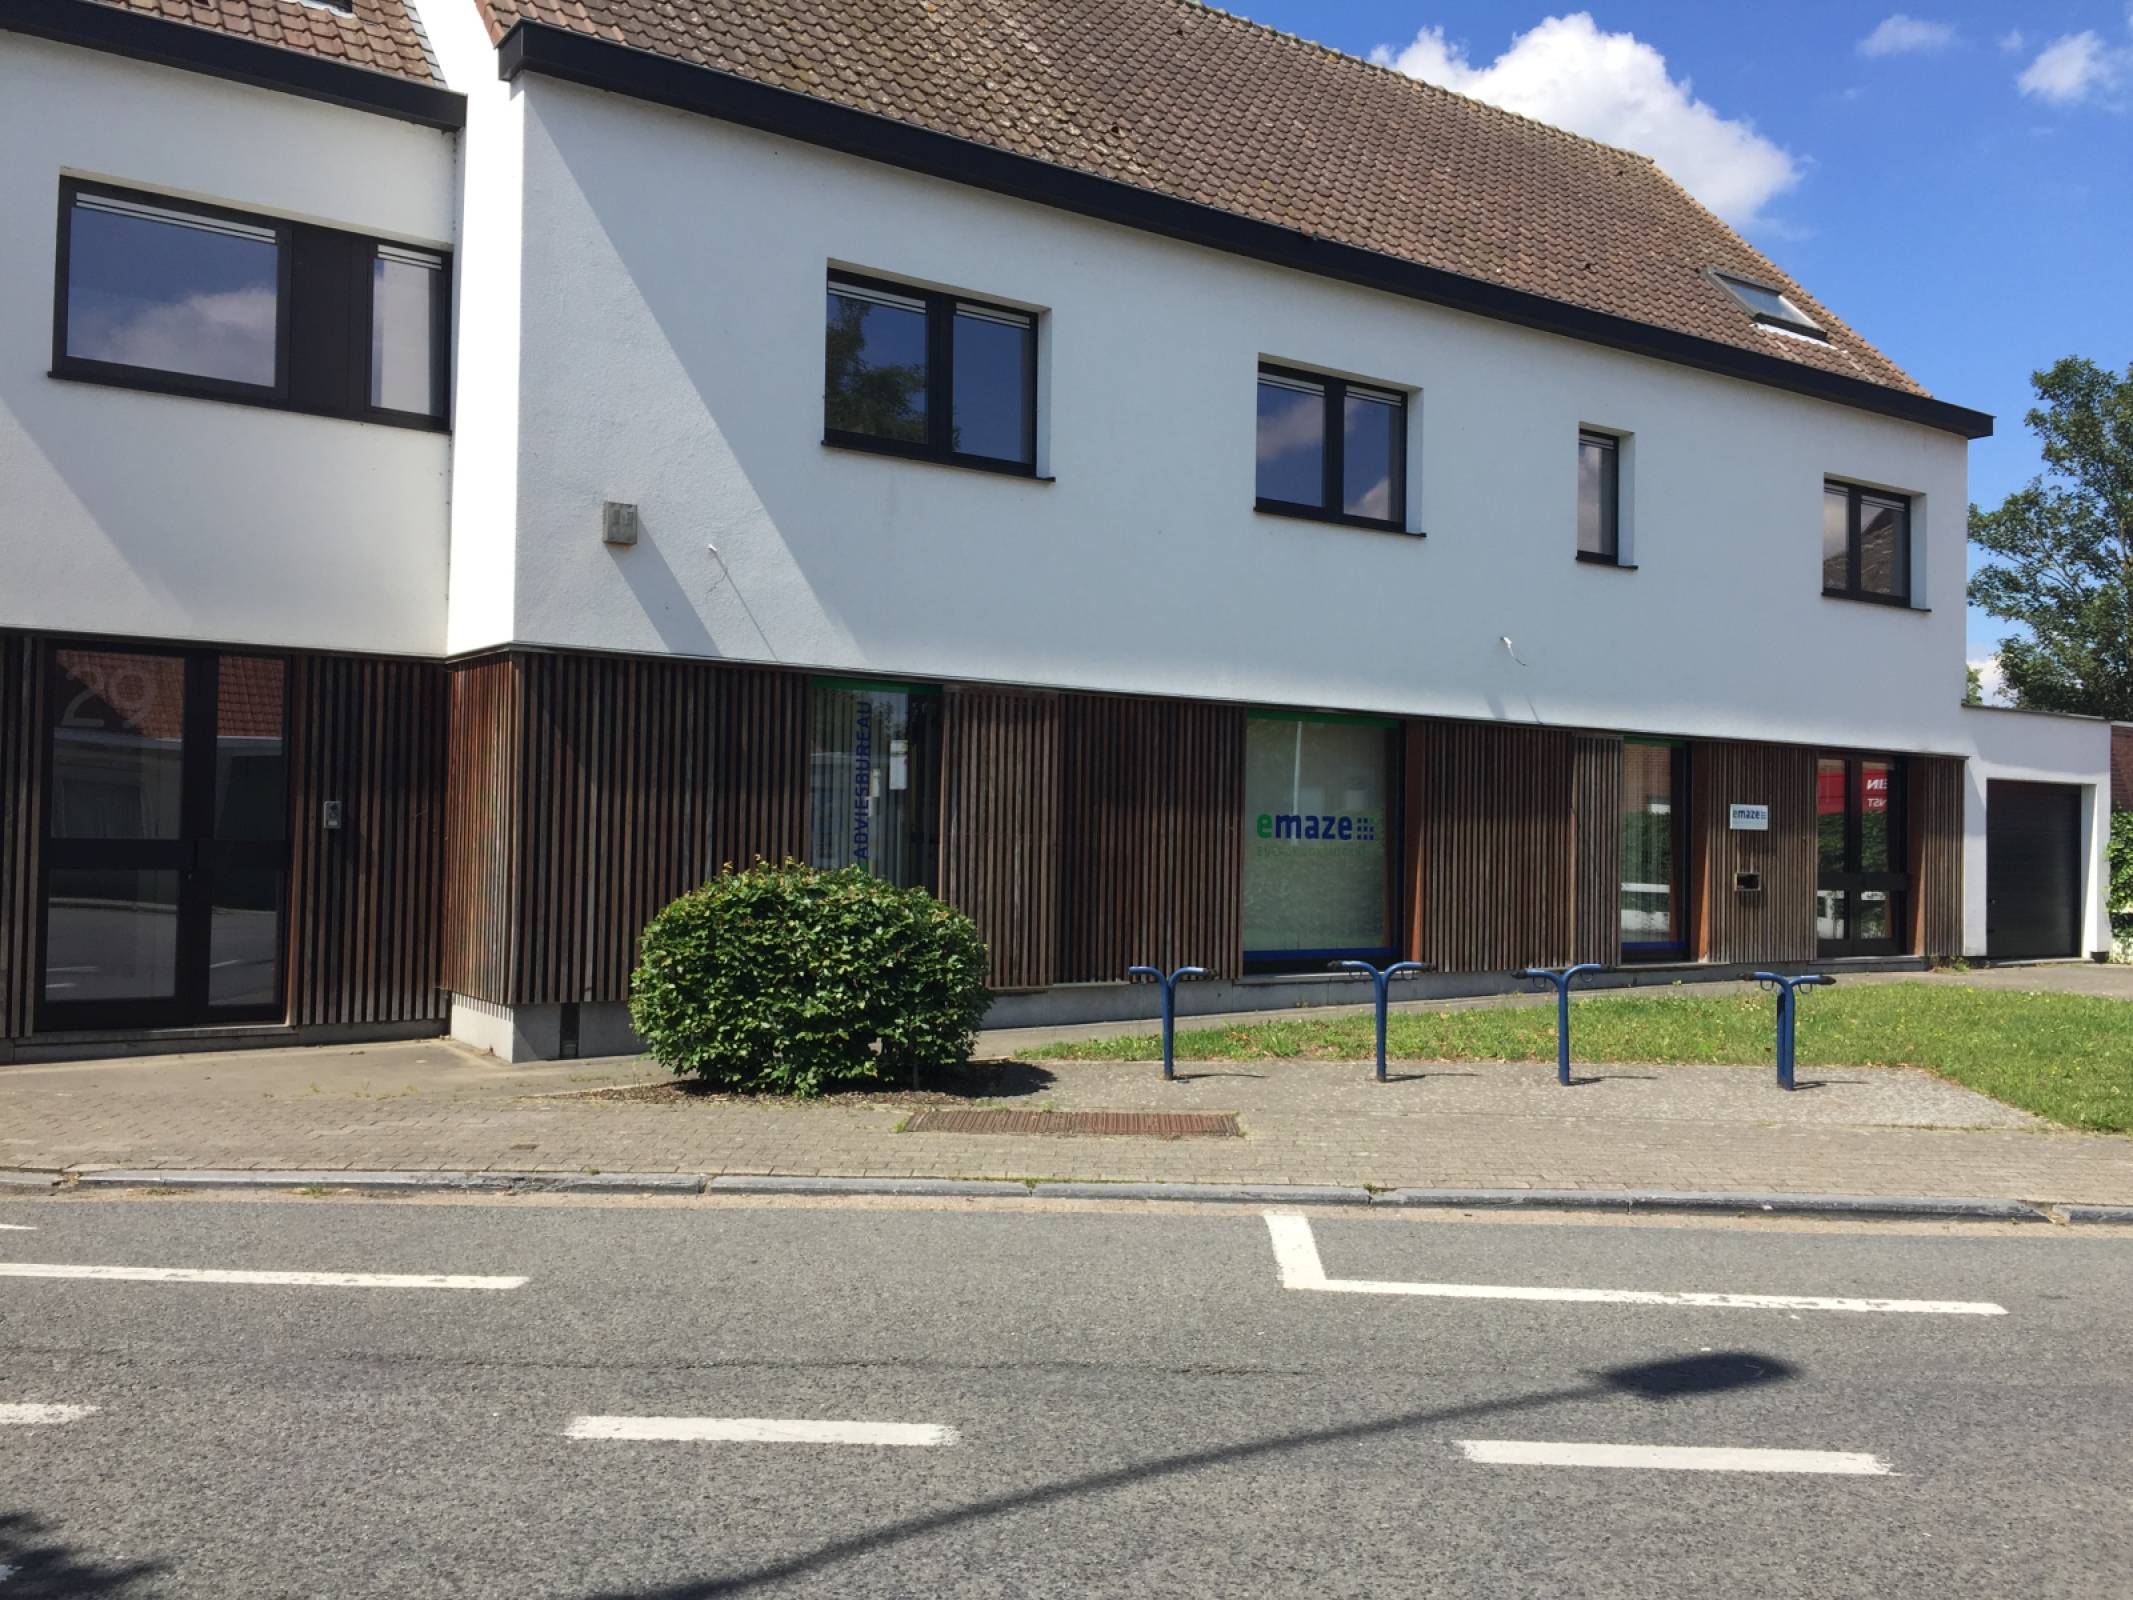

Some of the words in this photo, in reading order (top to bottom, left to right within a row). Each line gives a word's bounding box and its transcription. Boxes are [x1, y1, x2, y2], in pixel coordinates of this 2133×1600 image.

[853, 701, 872, 859] ADVIESBUREAU
[1256, 813, 1353, 841] emaze
[1732, 809, 1760, 820] emaze
